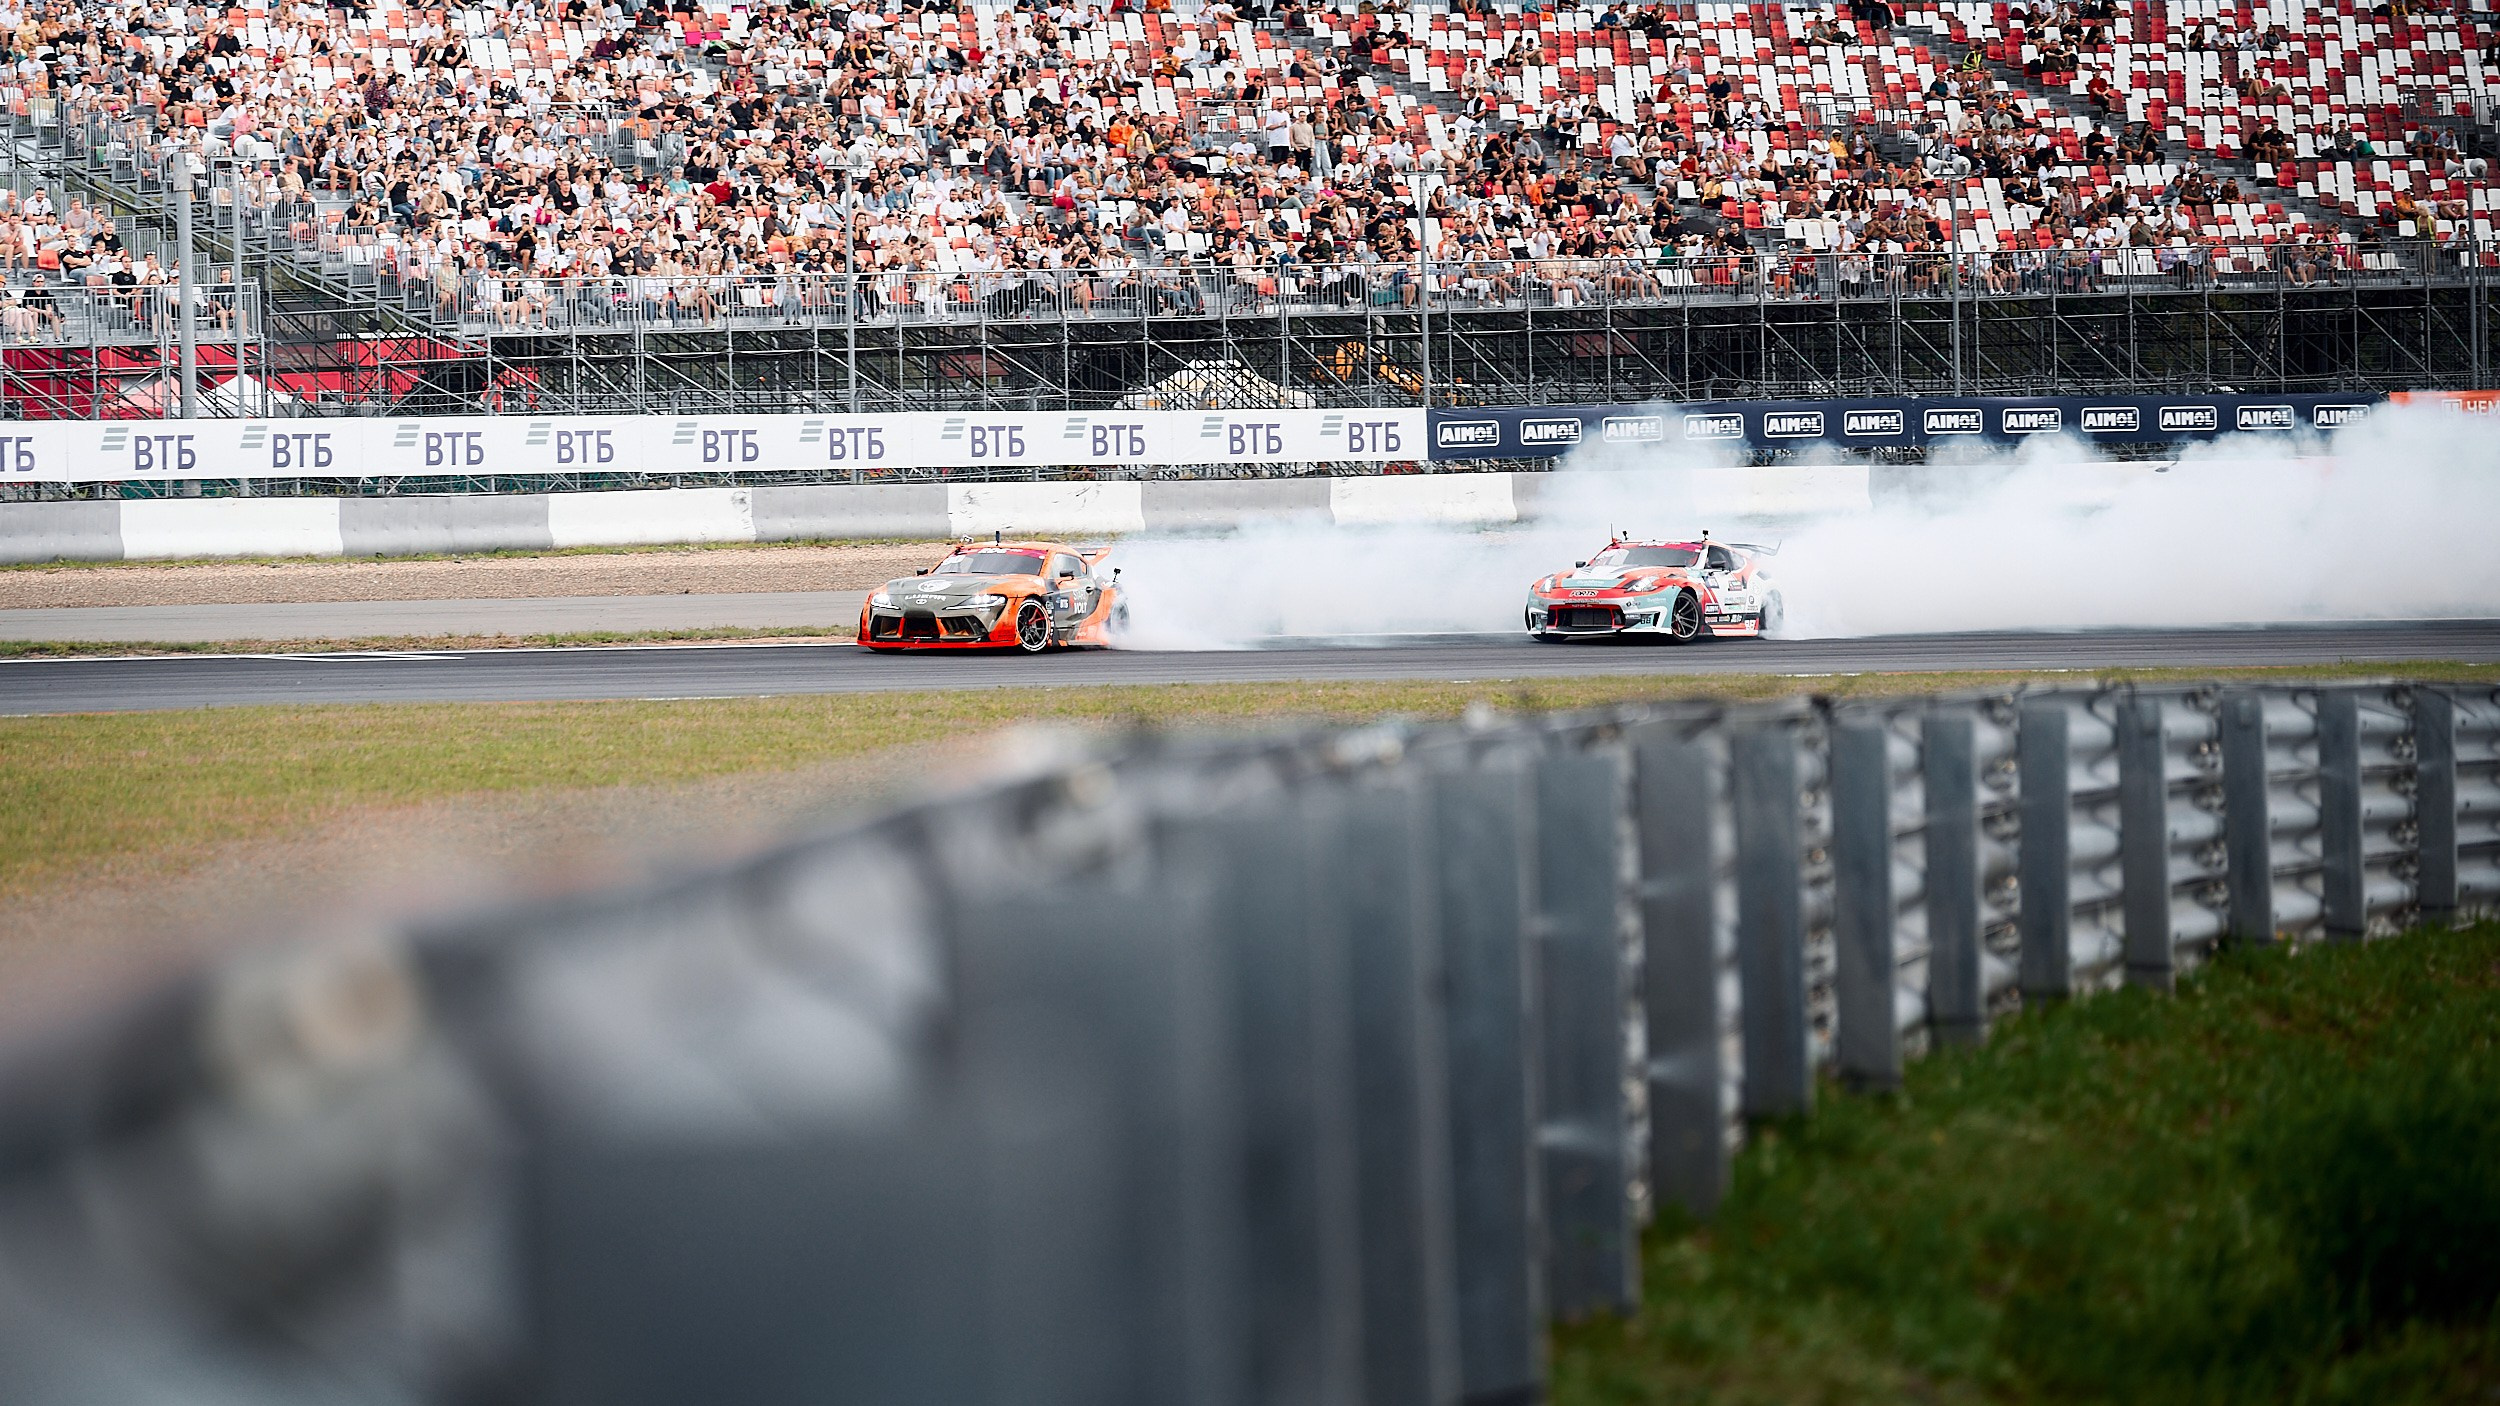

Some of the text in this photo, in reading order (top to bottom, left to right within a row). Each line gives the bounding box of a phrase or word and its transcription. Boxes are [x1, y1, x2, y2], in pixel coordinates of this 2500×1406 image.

[1686, 417, 1741, 434] AIMOL
[1767, 415, 1821, 433] AIMOL
[1847, 413, 1900, 431] AIMOL
[1927, 412, 1980, 429] AIMOL
[2005, 411, 2058, 428] AIMOL
[2084, 410, 2137, 427] AIMOL
[2162, 409, 2214, 426] AIMOL
[2239, 408, 2292, 425] AIMOL
[1349, 422, 1400, 452] ВТБ
[1440, 424, 1497, 442] AIMOL
[1523, 422, 1579, 440] AIMOL
[1605, 420, 1660, 438] AIMOL
[557, 430, 613, 463] ВТБ
[703, 430, 758, 462] ВТБ
[830, 428, 884, 460] ВТБ
[971, 426, 1024, 457] ВТБ
[1093, 425, 1145, 456] ВТБ
[1229, 424, 1282, 454] ВТБ
[135, 435, 195, 470] ВТБ
[273, 434, 332, 467] ВТБ
[426, 432, 483, 465] ВТБ
